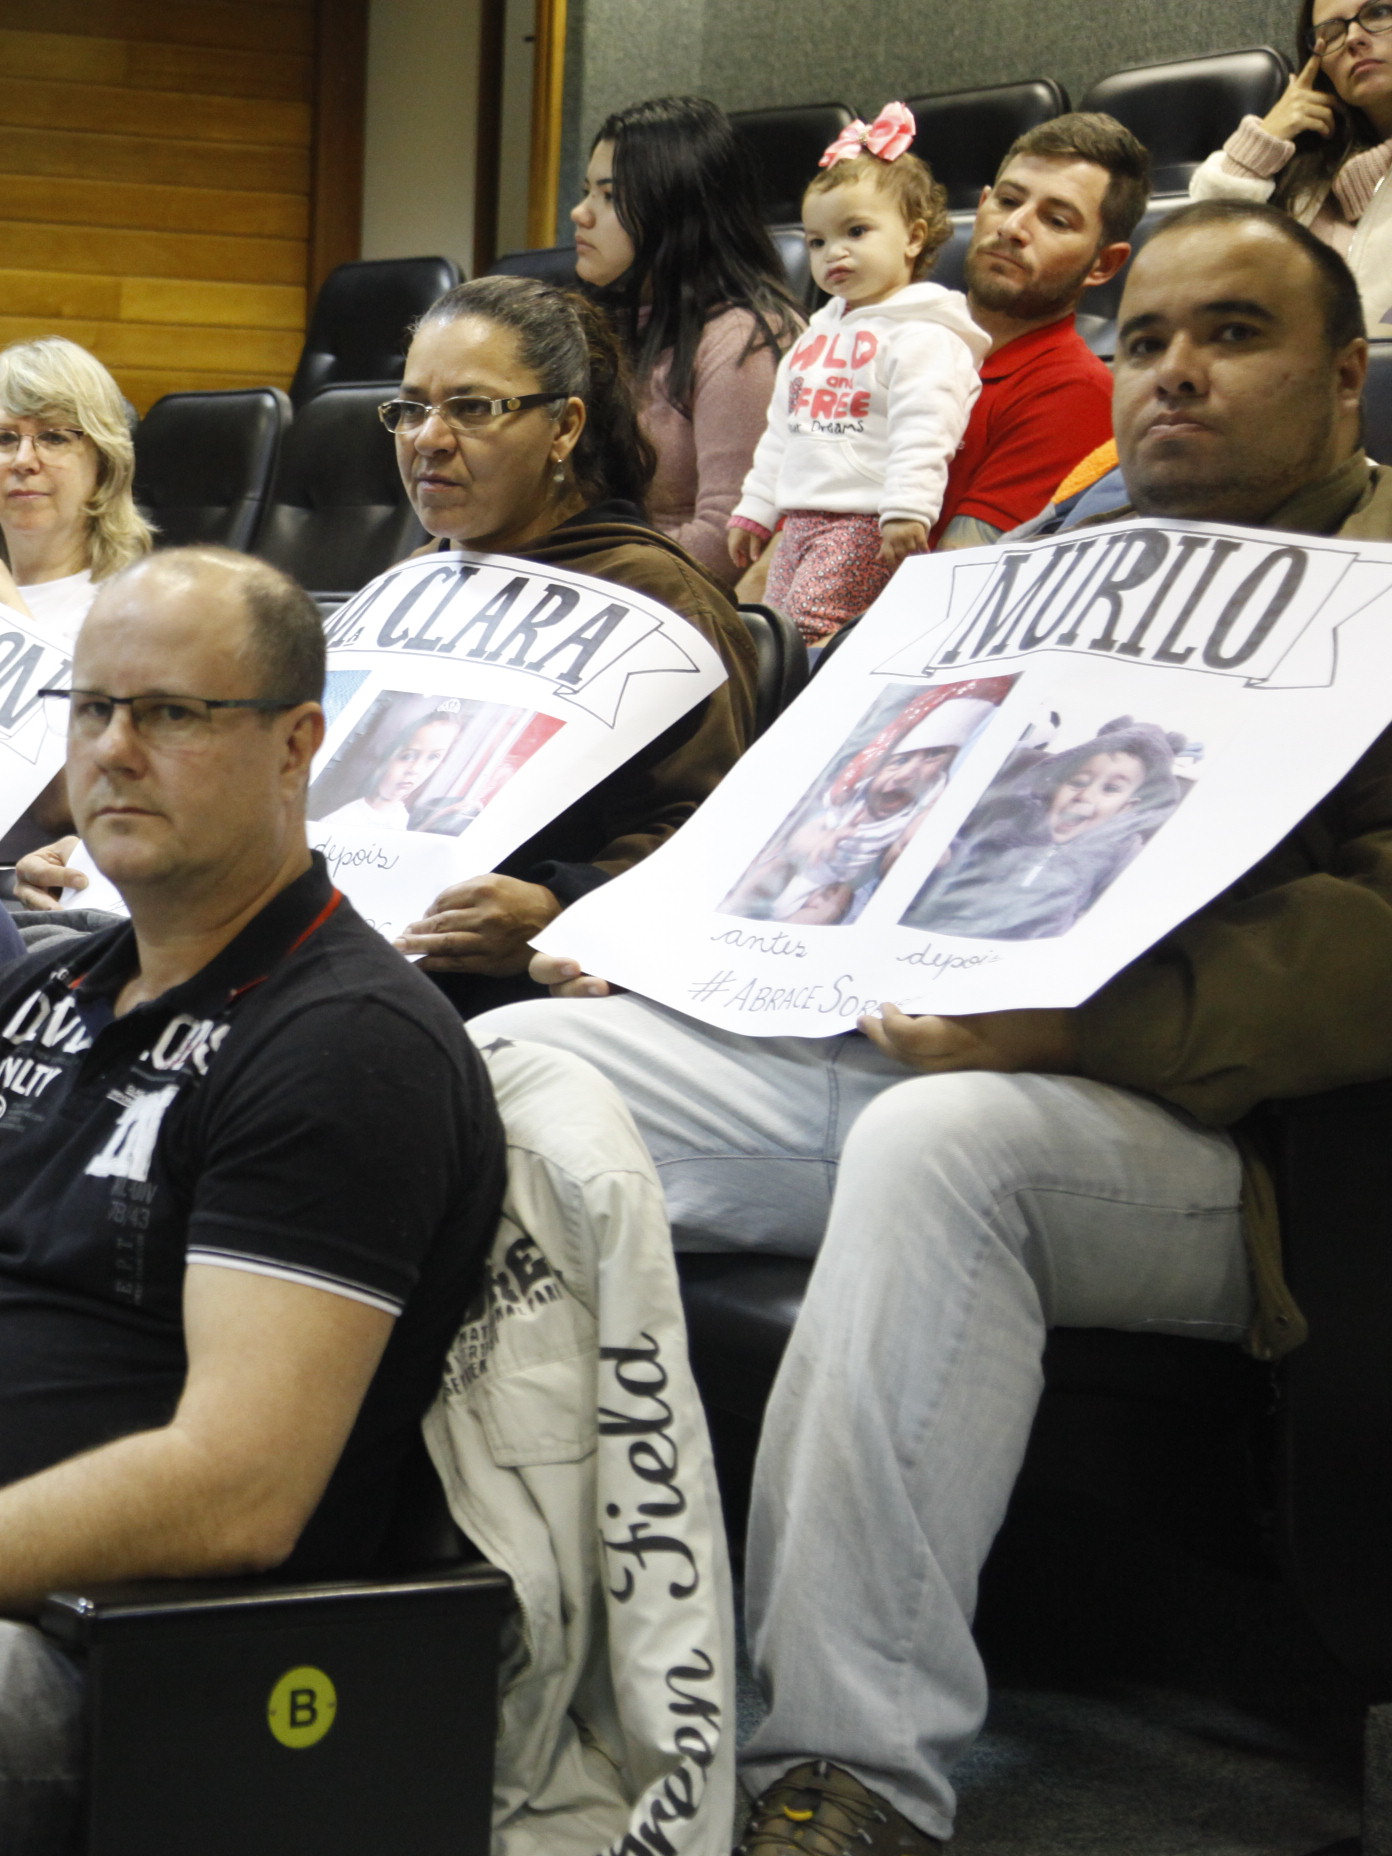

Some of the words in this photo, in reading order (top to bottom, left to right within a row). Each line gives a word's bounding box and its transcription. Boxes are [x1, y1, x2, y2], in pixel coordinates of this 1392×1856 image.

[795, 387, 871, 419] FREE
[812, 420, 864, 434] Dreams
[377, 566, 630, 685] CLARA
[942, 528, 1309, 672] MURILO
[598, 1331, 700, 1603] Field
[289, 1688, 318, 1729] B
[596, 1648, 722, 1856] reen
